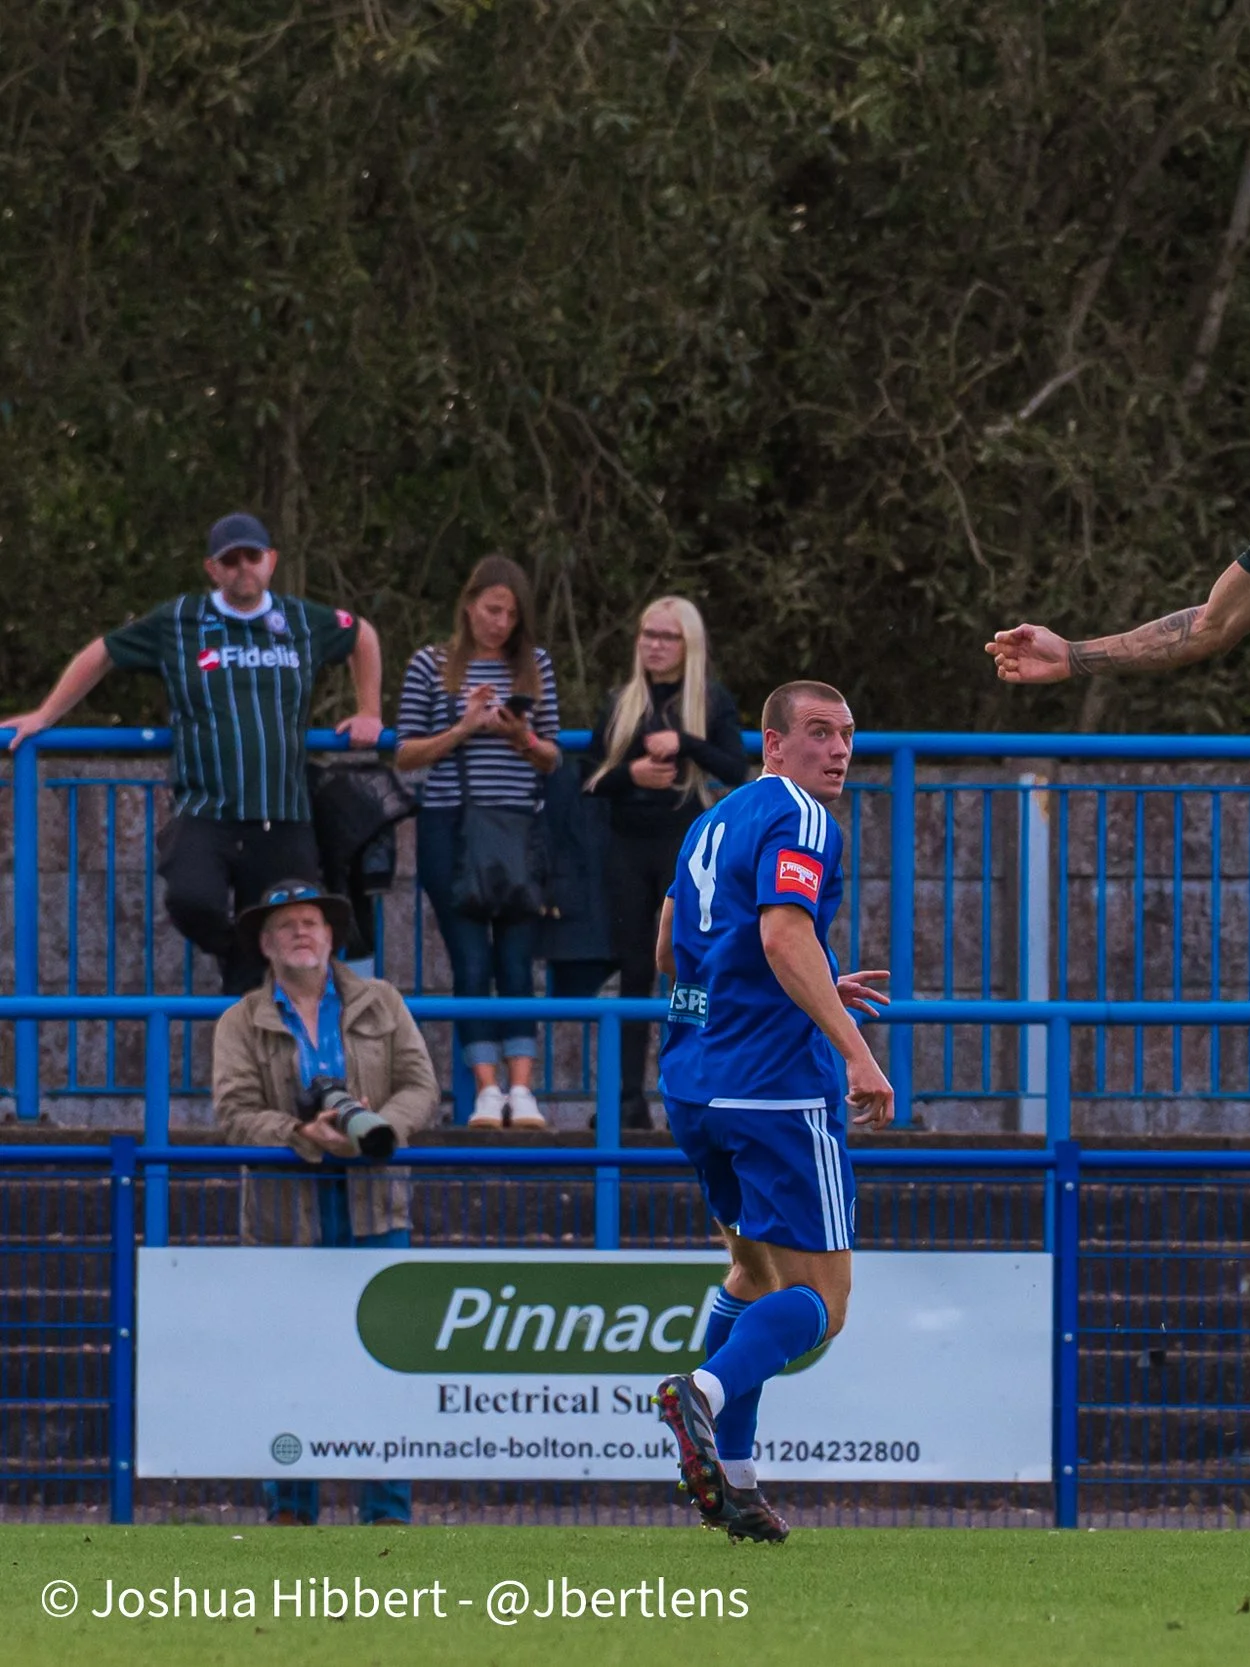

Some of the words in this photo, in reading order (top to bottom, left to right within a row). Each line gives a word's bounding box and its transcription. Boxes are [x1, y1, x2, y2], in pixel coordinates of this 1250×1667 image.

[221, 645, 299, 669] Fidelis
[687, 820, 726, 933] 4
[438, 1384, 598, 1414] Electrical
[613, 1385, 660, 1417] Su
[311, 1437, 677, 1464] www.pinnacle-bolton.co.uk
